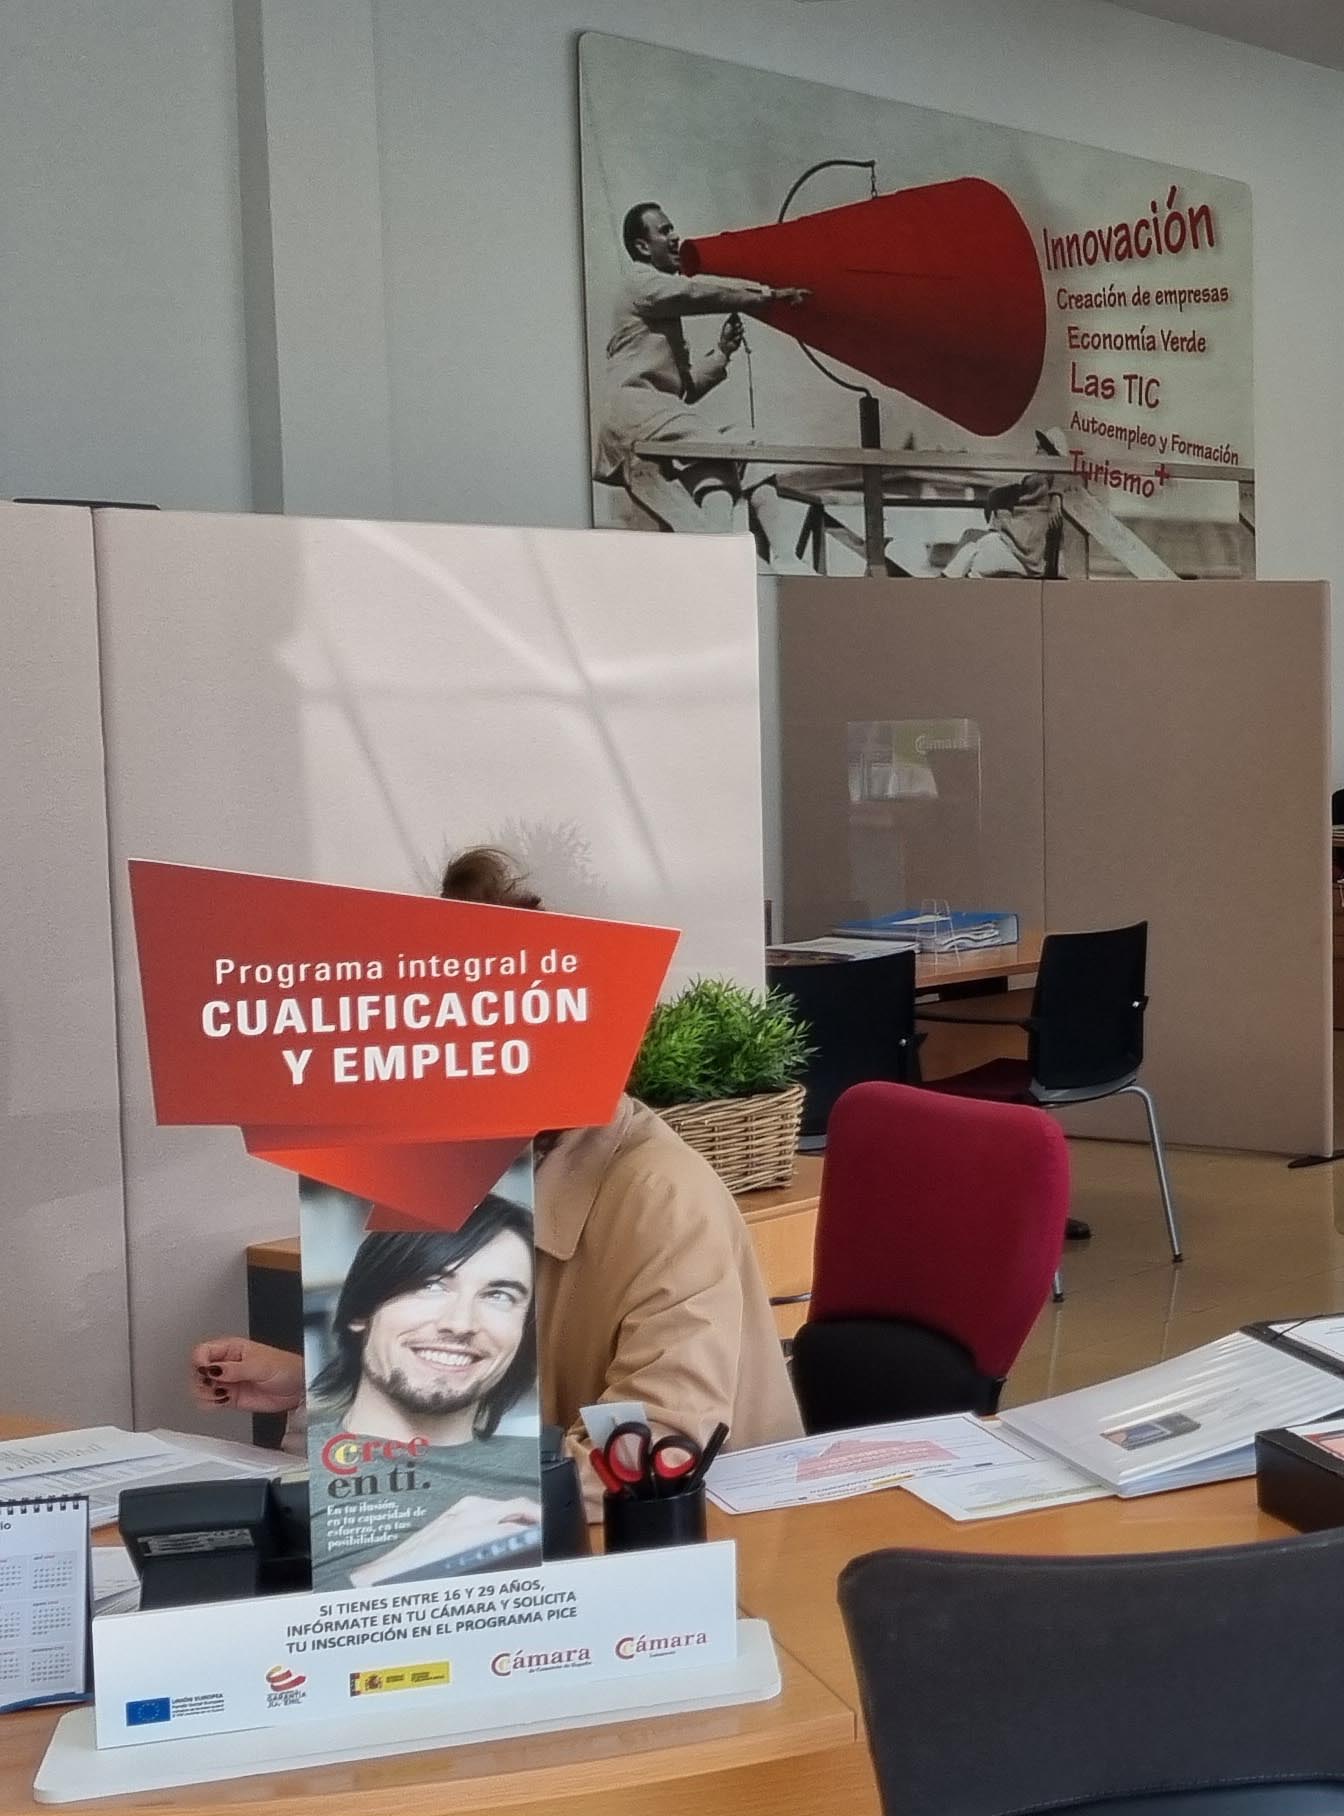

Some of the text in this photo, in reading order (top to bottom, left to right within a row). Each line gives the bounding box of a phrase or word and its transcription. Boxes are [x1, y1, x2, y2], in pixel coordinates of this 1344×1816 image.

[1043, 185, 1215, 271] Innovación
[1057, 283, 1229, 312] Creación de empresas
[1068, 325, 1206, 352] Economía Verde
[1070, 361, 1160, 409] Las TIC
[1070, 411, 1239, 466] Autoempleo y Formación
[215, 949, 577, 989] Programa integral de
[201, 979, 589, 1037] CUALIFICACIÓN
[282, 1039, 531, 1085] Y EMPLEO
[321, 1432, 430, 1475] Cree
[327, 1461, 431, 1499] en ti.
[287, 1591, 577, 1637] INFÓRMATE EN TU CÁMARA Y SOLICITA
[320, 1579, 545, 1617] SI TIENES ENTRE 16 Y 29 AÑOS,
[286, 1606, 578, 1654] TU INSCRIPCIÓN EN EL PROGRAMA PICE
[614, 1631, 708, 1660] Cámara
[491, 1647, 591, 1676] Cámara
